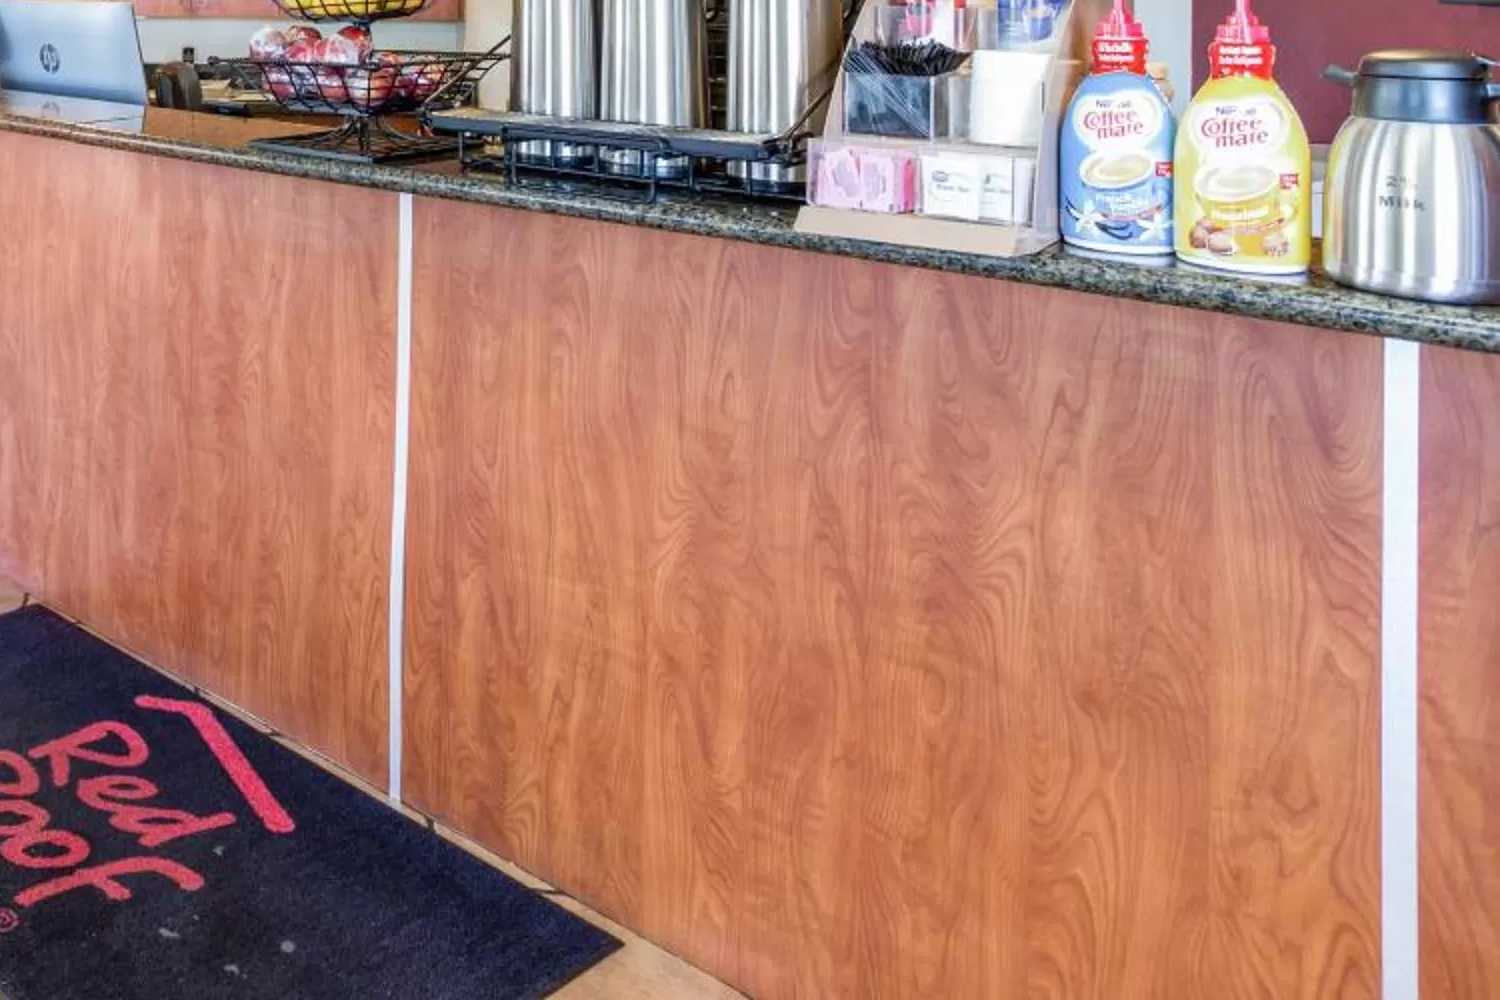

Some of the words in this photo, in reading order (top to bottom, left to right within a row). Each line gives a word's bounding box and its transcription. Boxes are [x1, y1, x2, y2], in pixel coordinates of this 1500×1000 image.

[1083, 109, 1138, 133] Coffee
[1201, 117, 1264, 138] Coffee
[27, 720, 236, 849] Red
